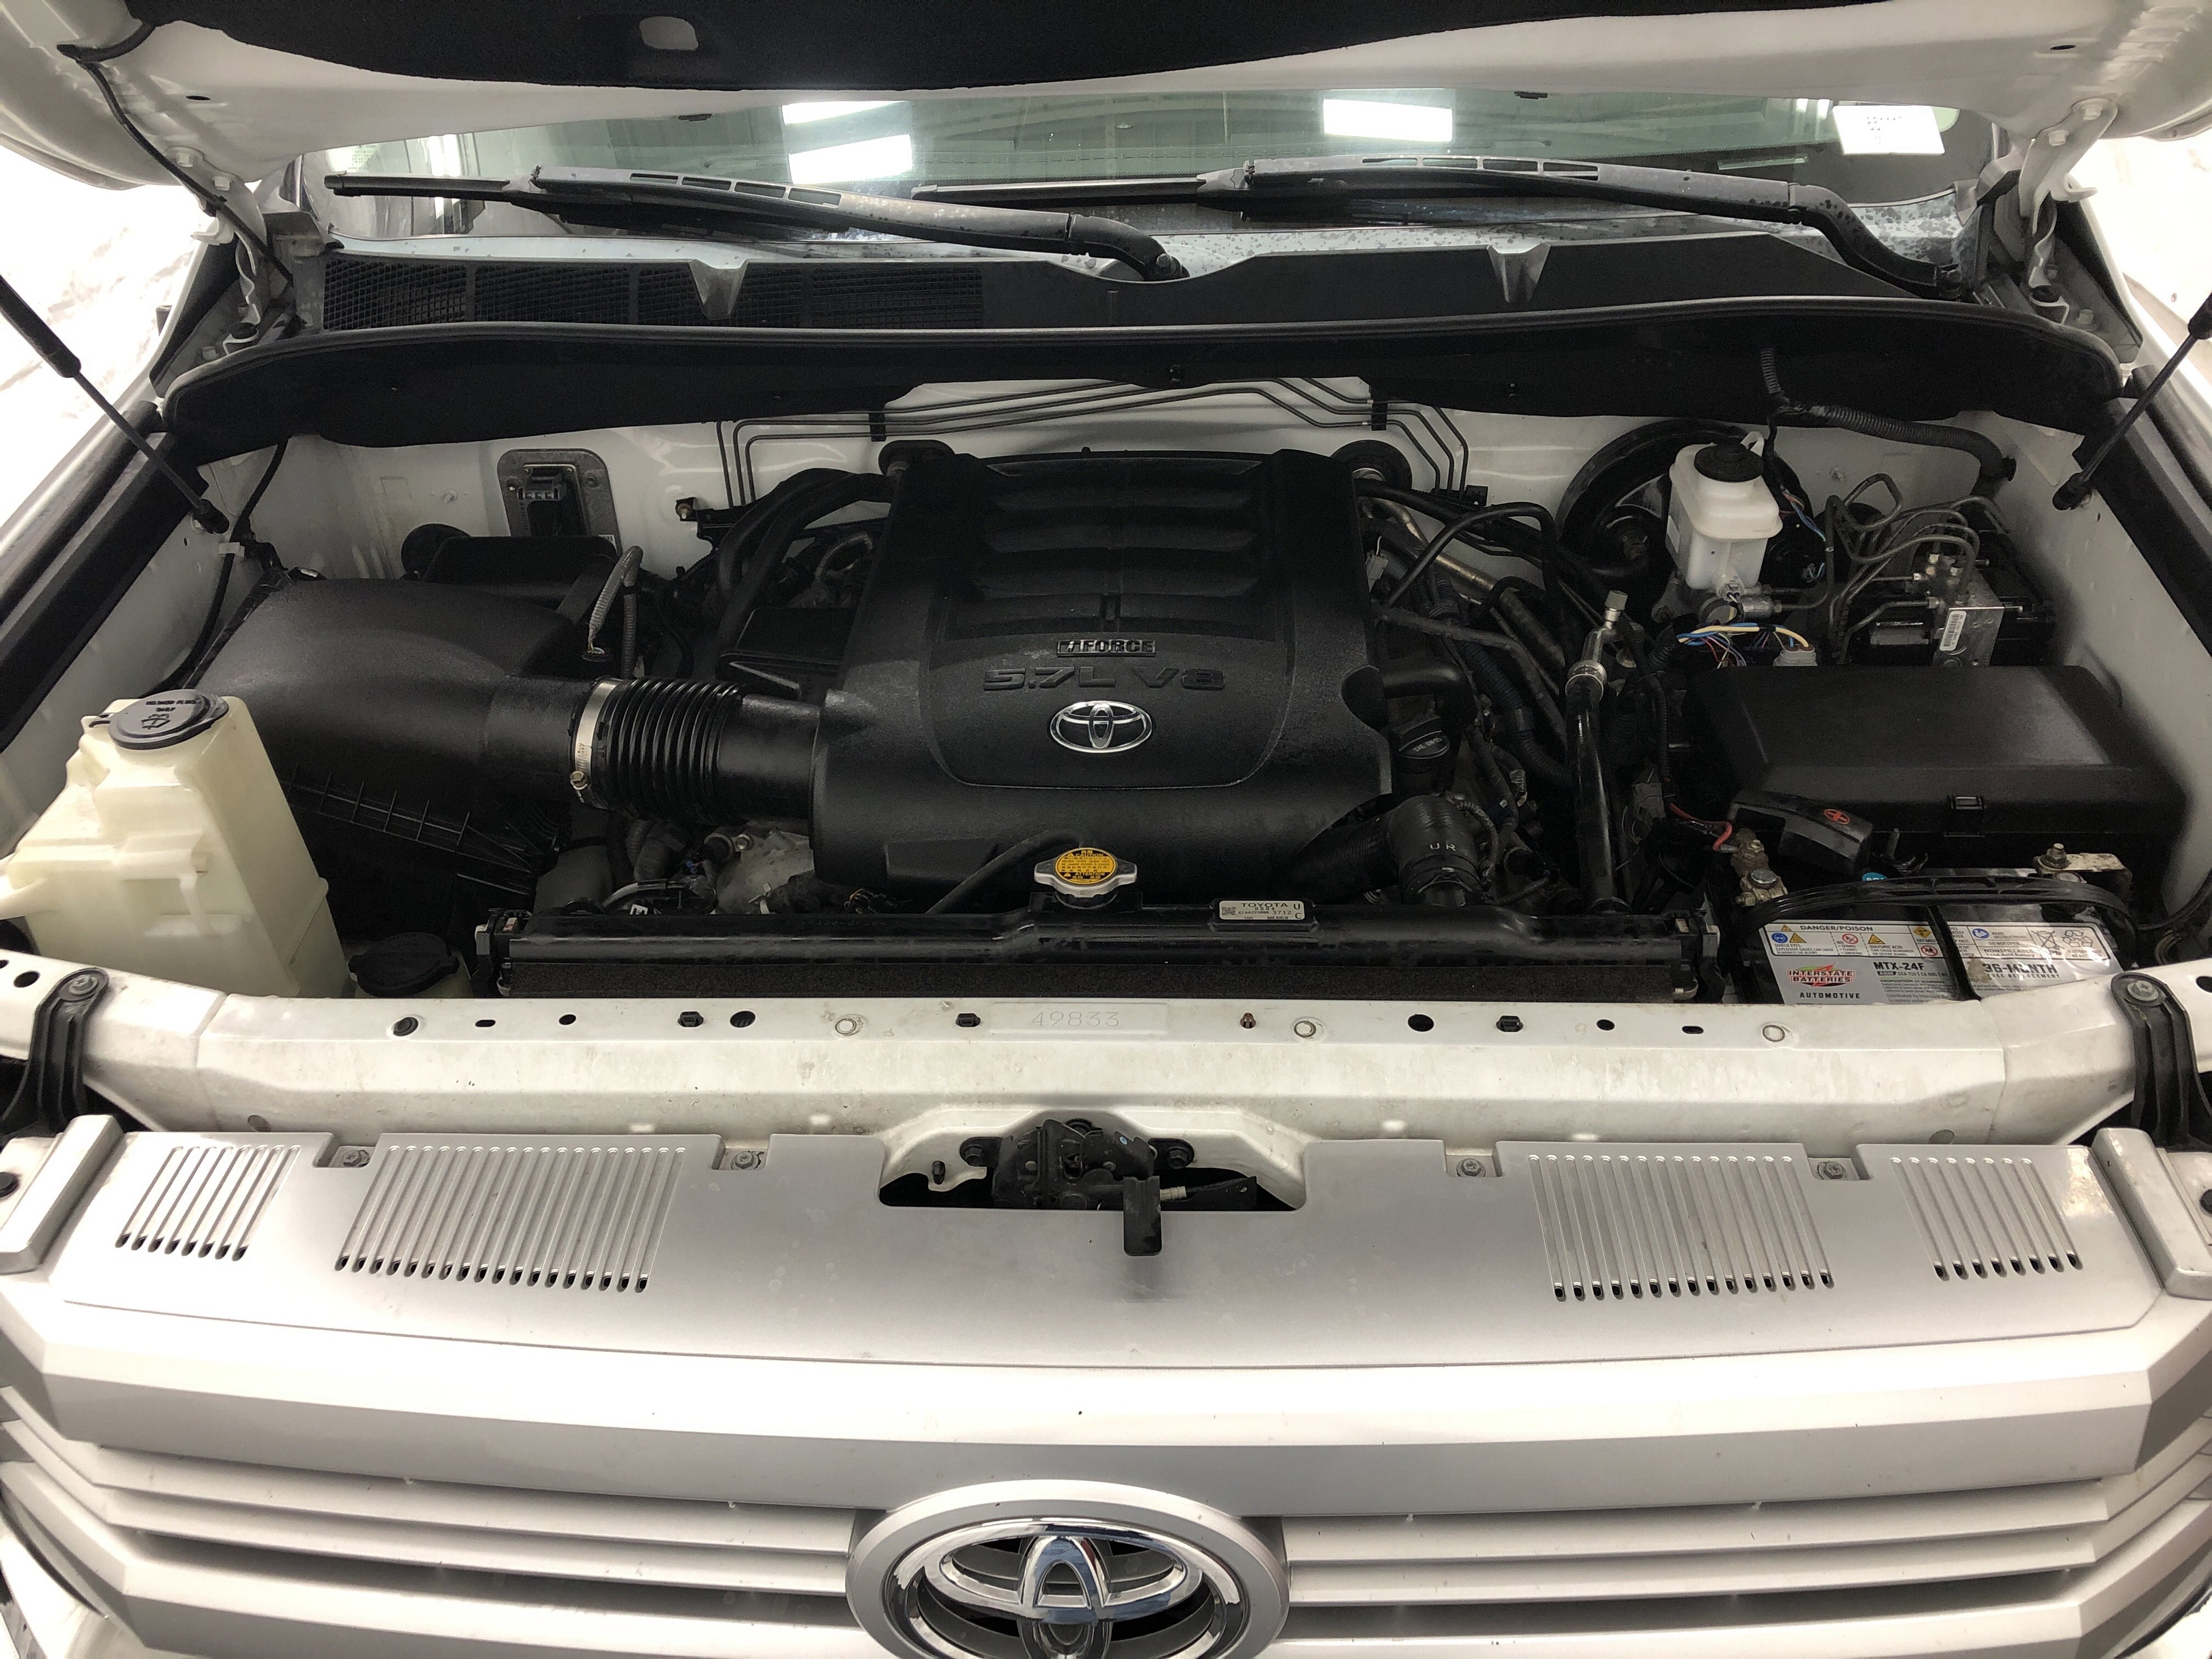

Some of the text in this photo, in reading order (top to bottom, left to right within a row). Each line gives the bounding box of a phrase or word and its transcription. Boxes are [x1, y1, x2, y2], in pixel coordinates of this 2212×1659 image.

[984, 666, 1226, 691] 5.7L V8
[1873, 962, 1925, 970] MTX-24F
[1031, 1011, 1119, 1027] 49833
